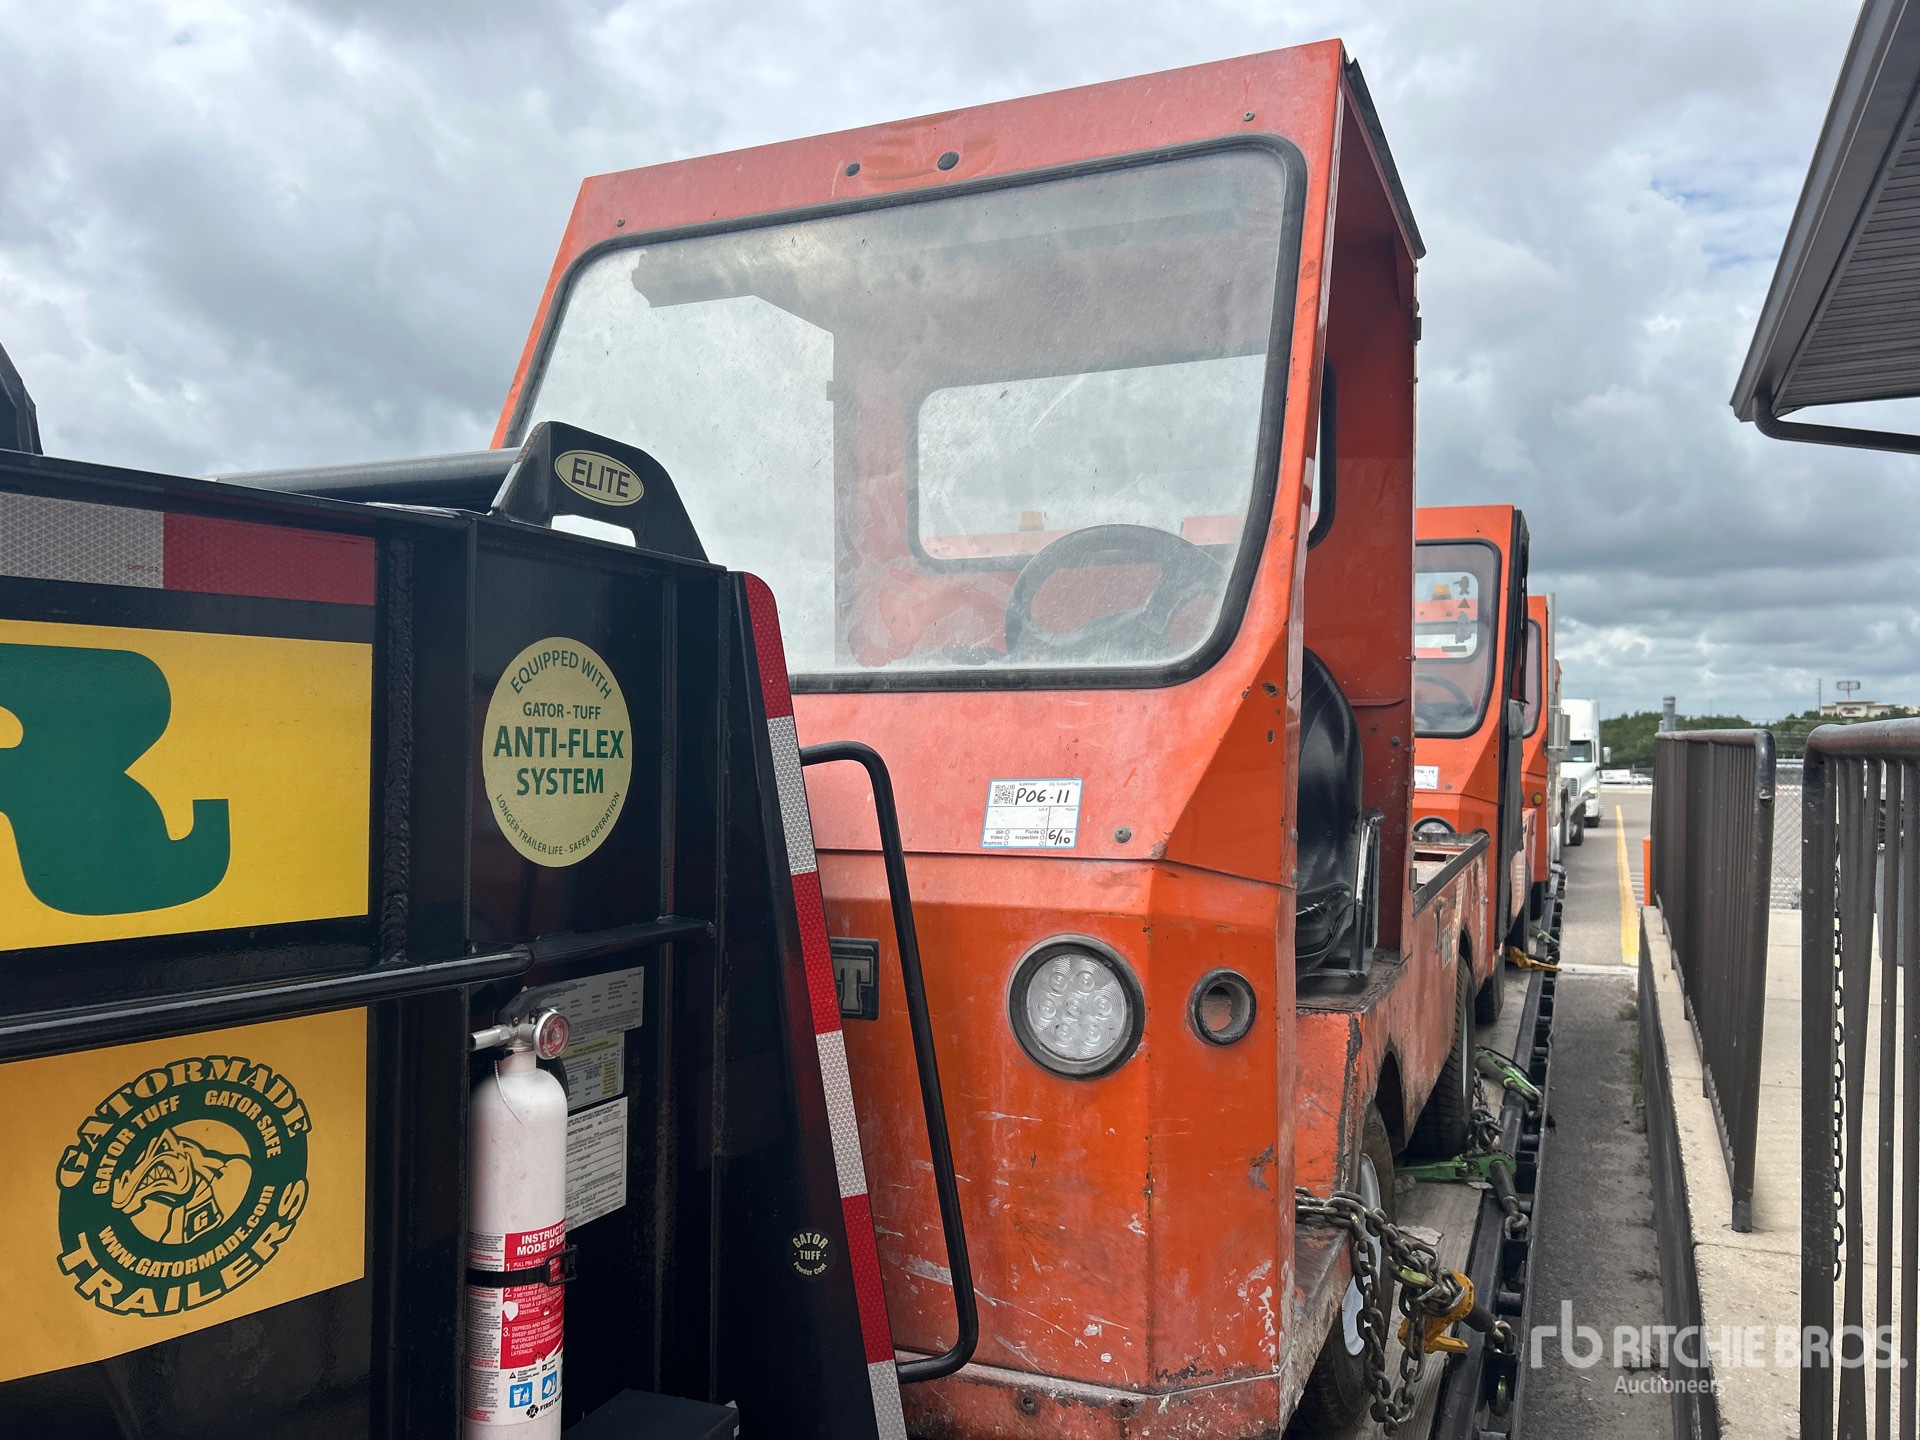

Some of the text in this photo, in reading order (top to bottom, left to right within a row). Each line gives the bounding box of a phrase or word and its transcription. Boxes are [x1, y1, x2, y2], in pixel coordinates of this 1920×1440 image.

[571, 457, 630, 498] ELITE
[510, 650, 612, 699] EQUIPPED WITH
[523, 702, 564, 718] GATOR
[573, 705, 601, 720] TUFF
[493, 725, 624, 759] ANTI-FLEX
[516, 768, 604, 796] SYSTEM
[496, 793, 520, 831] LONGER
[519, 829, 547, 854] TRAILER
[548, 845, 563, 855] LIFE
[569, 835, 591, 853] SAFER
[590, 791, 620, 840] OPERATION
[1048, 829, 1071, 845] 6/10
[60, 1058, 308, 1188] GATORMADE
[204, 1090, 282, 1159] GATOR SAFE
[92, 1095, 180, 1195] GATOR TUFF
[61, 1179, 306, 1313] TRAILERS
[98, 1185, 276, 1278] WWW.GATORMADE.com
[516, 1242, 547, 1256] MODE
[792, 1232, 829, 1249] GATOR
[799, 1250, 821, 1260] TUFF
[540, 1399, 554, 1411] FIRST
